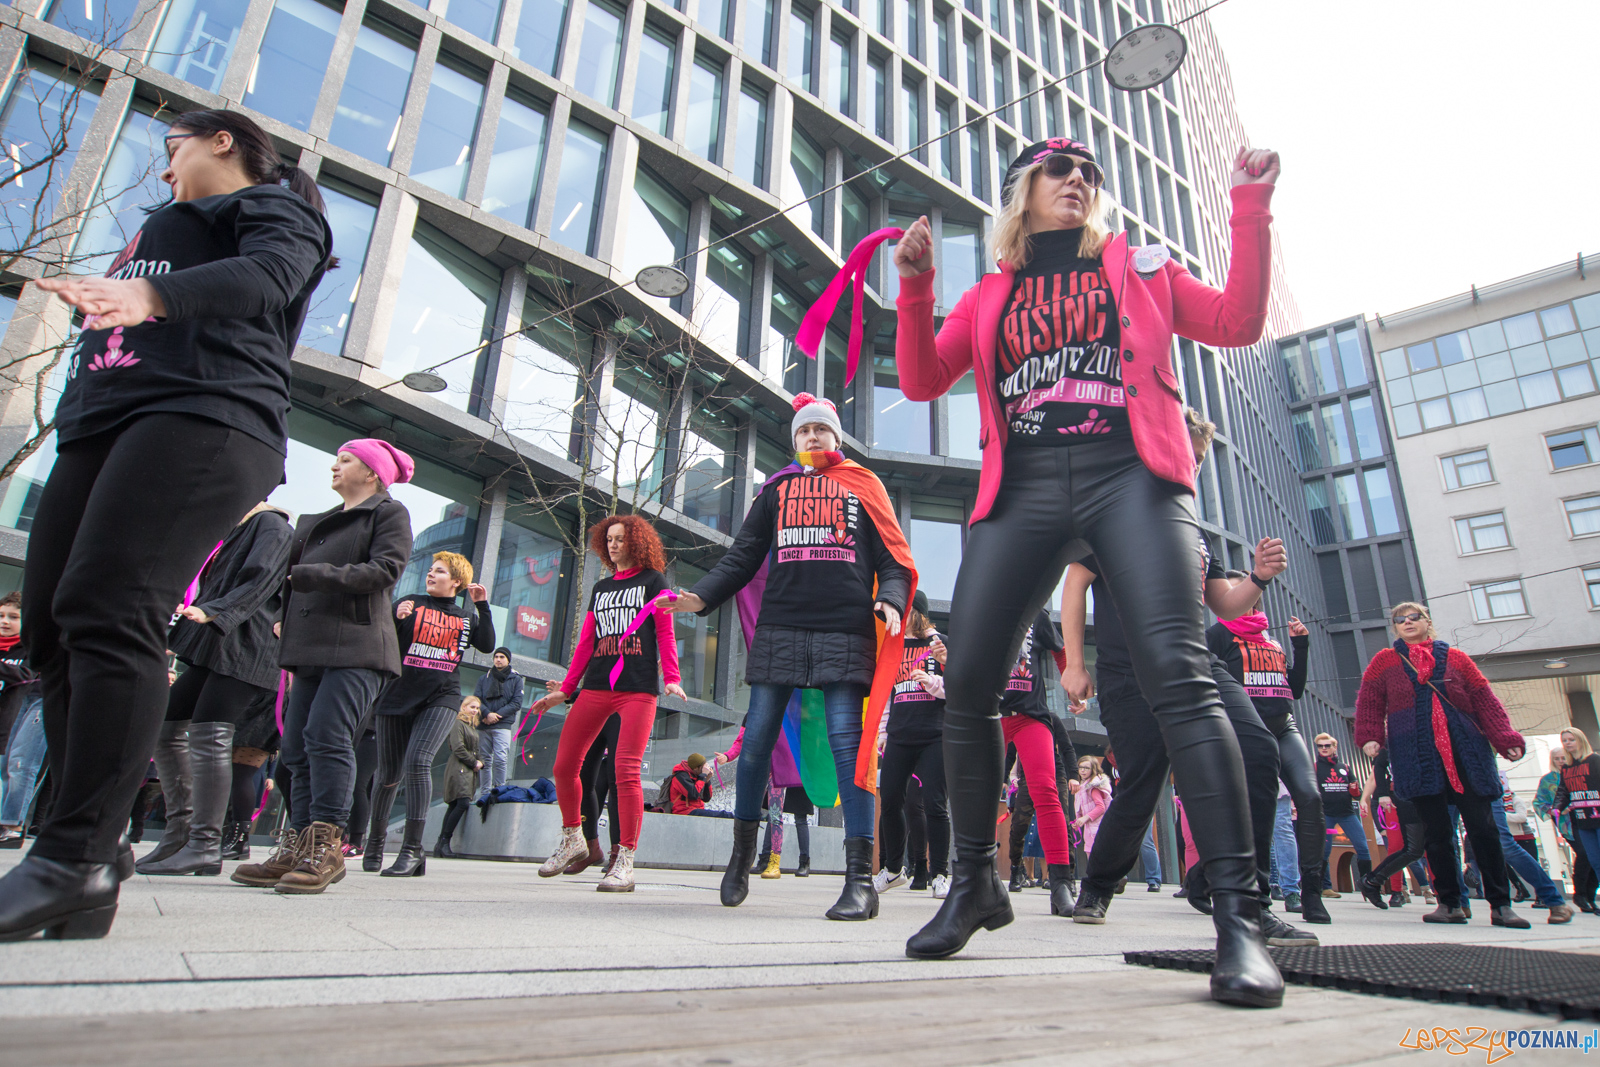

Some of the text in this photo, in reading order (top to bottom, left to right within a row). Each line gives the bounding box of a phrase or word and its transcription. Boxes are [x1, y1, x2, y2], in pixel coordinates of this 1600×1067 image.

[1004, 290, 1107, 367] RISING
[1075, 382, 1124, 403] UNITE!
[788, 476, 849, 499] BILLION
[786, 498, 844, 527] RISING
[781, 548, 851, 561] TAŃCZ! PROTESTUJ!
[597, 585, 646, 611] BILLION
[424, 608, 465, 631] BILLION
[418, 622, 460, 649] RISING
